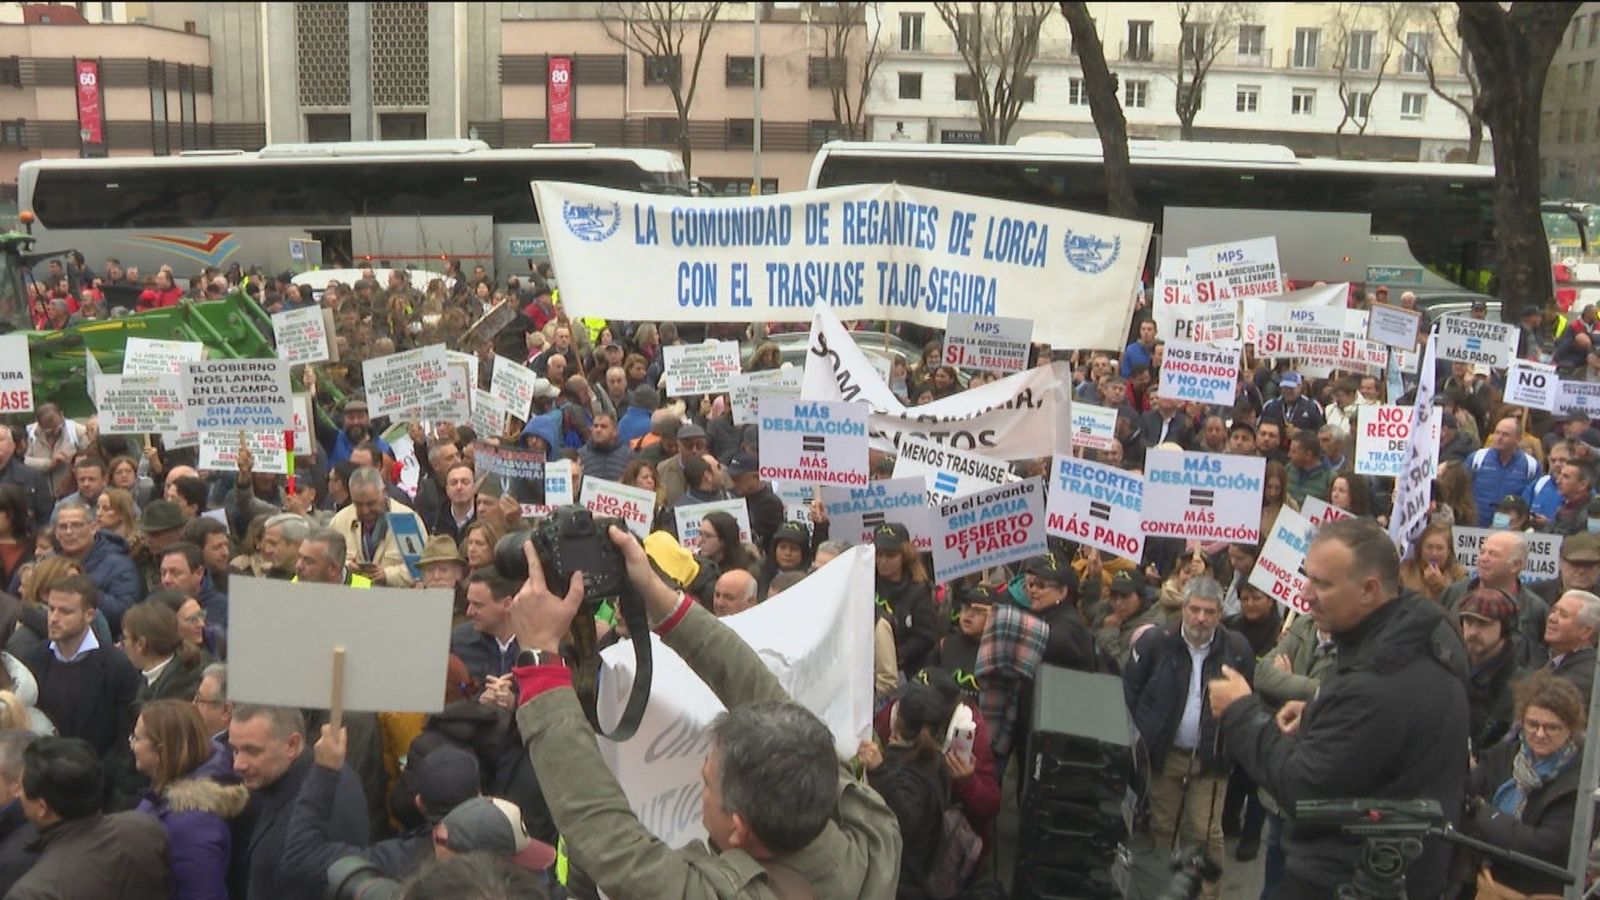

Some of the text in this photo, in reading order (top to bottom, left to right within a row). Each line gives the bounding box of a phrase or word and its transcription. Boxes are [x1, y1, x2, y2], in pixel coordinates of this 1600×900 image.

[552, 70, 568, 83] 80
[634, 203, 659, 245] LA
[671, 204, 791, 247] COMUNIDAD
[805, 203, 830, 246] DE
[843, 199, 938, 251] REGANTES
[948, 210, 977, 257] DE
[983, 216, 1049, 269] LORCA
[1217, 250, 1244, 263] MPS
[1196, 263, 1276, 281] CON LA AGRICULTURA
[677, 261, 997, 316] CON EL TRASVASE TAJO-SEGURA
[1164, 287, 1179, 304] SI
[1196, 280, 1278, 304] SI AL TRASVASE
[1290, 310, 1315, 321] MPS
[974, 322, 1000, 334] MPS
[1194, 324, 1205, 342] SI
[1267, 324, 1341, 336] CON LA AGRICULTURA
[1446, 318, 1508, 334] RECORTES
[1447, 326, 1506, 342] TRASVASE
[977, 339, 1026, 350] AGRICULTURA
[1265, 333, 1339, 356] SI AL TRASVASE
[1342, 340, 1356, 359] SI
[946, 344, 1024, 371] SI AL TRASVASE
[1167, 348, 1235, 365] NOS ESTÁIS
[1470, 353, 1497, 365] PARO
[189, 363, 276, 374] EL GOBIERNO
[1163, 360, 1236, 378] AHOGANDO
[193, 375, 222, 384] NOS
[1166, 373, 1231, 391] Y NO CON
[1518, 372, 1546, 388] NO
[192, 385, 279, 395] EN EL CAMPO
[1176, 386, 1215, 400] AGUA
[187, 395, 286, 406] DE CARTAGENA
[206, 406, 272, 416] SIN AGUA
[794, 401, 830, 419] MÁS
[1378, 408, 1404, 423] NO
[197, 416, 284, 427] NO HAY VIDA
[762, 418, 865, 436] DESALACIÓN
[1367, 424, 1410, 438] RECO
[1388, 440, 1408, 451] DE
[799, 452, 828, 469] MÁS
[901, 441, 1005, 484] MENOS TRASVASE
[1184, 456, 1222, 473] MÁS
[1368, 451, 1405, 463] TRASV
[760, 466, 868, 485] CONTAMINACIÓN
[1059, 460, 1143, 493] RECORTES
[1150, 468, 1260, 491] DESALACIÓN
[850, 483, 886, 499] MÁS
[1059, 476, 1142, 512] TRASVASE
[597, 494, 640, 513] NO AL
[940, 503, 959, 517] En
[961, 498, 976, 512] el
[977, 484, 1035, 505] Levante
[586, 501, 648, 523] RECORTE
[948, 498, 1029, 529] SIN AGUA
[1184, 510, 1215, 523] MÁS
[945, 513, 1034, 550] DESIERTO
[1048, 513, 1139, 554] MÁS PARO
[1140, 519, 1258, 541] CONTAMINACIÓN
[958, 529, 1028, 559] Y PARO
[1458, 535, 1477, 548] SIN
[1258, 557, 1292, 583] MENOS
[1272, 581, 1292, 601] DE
